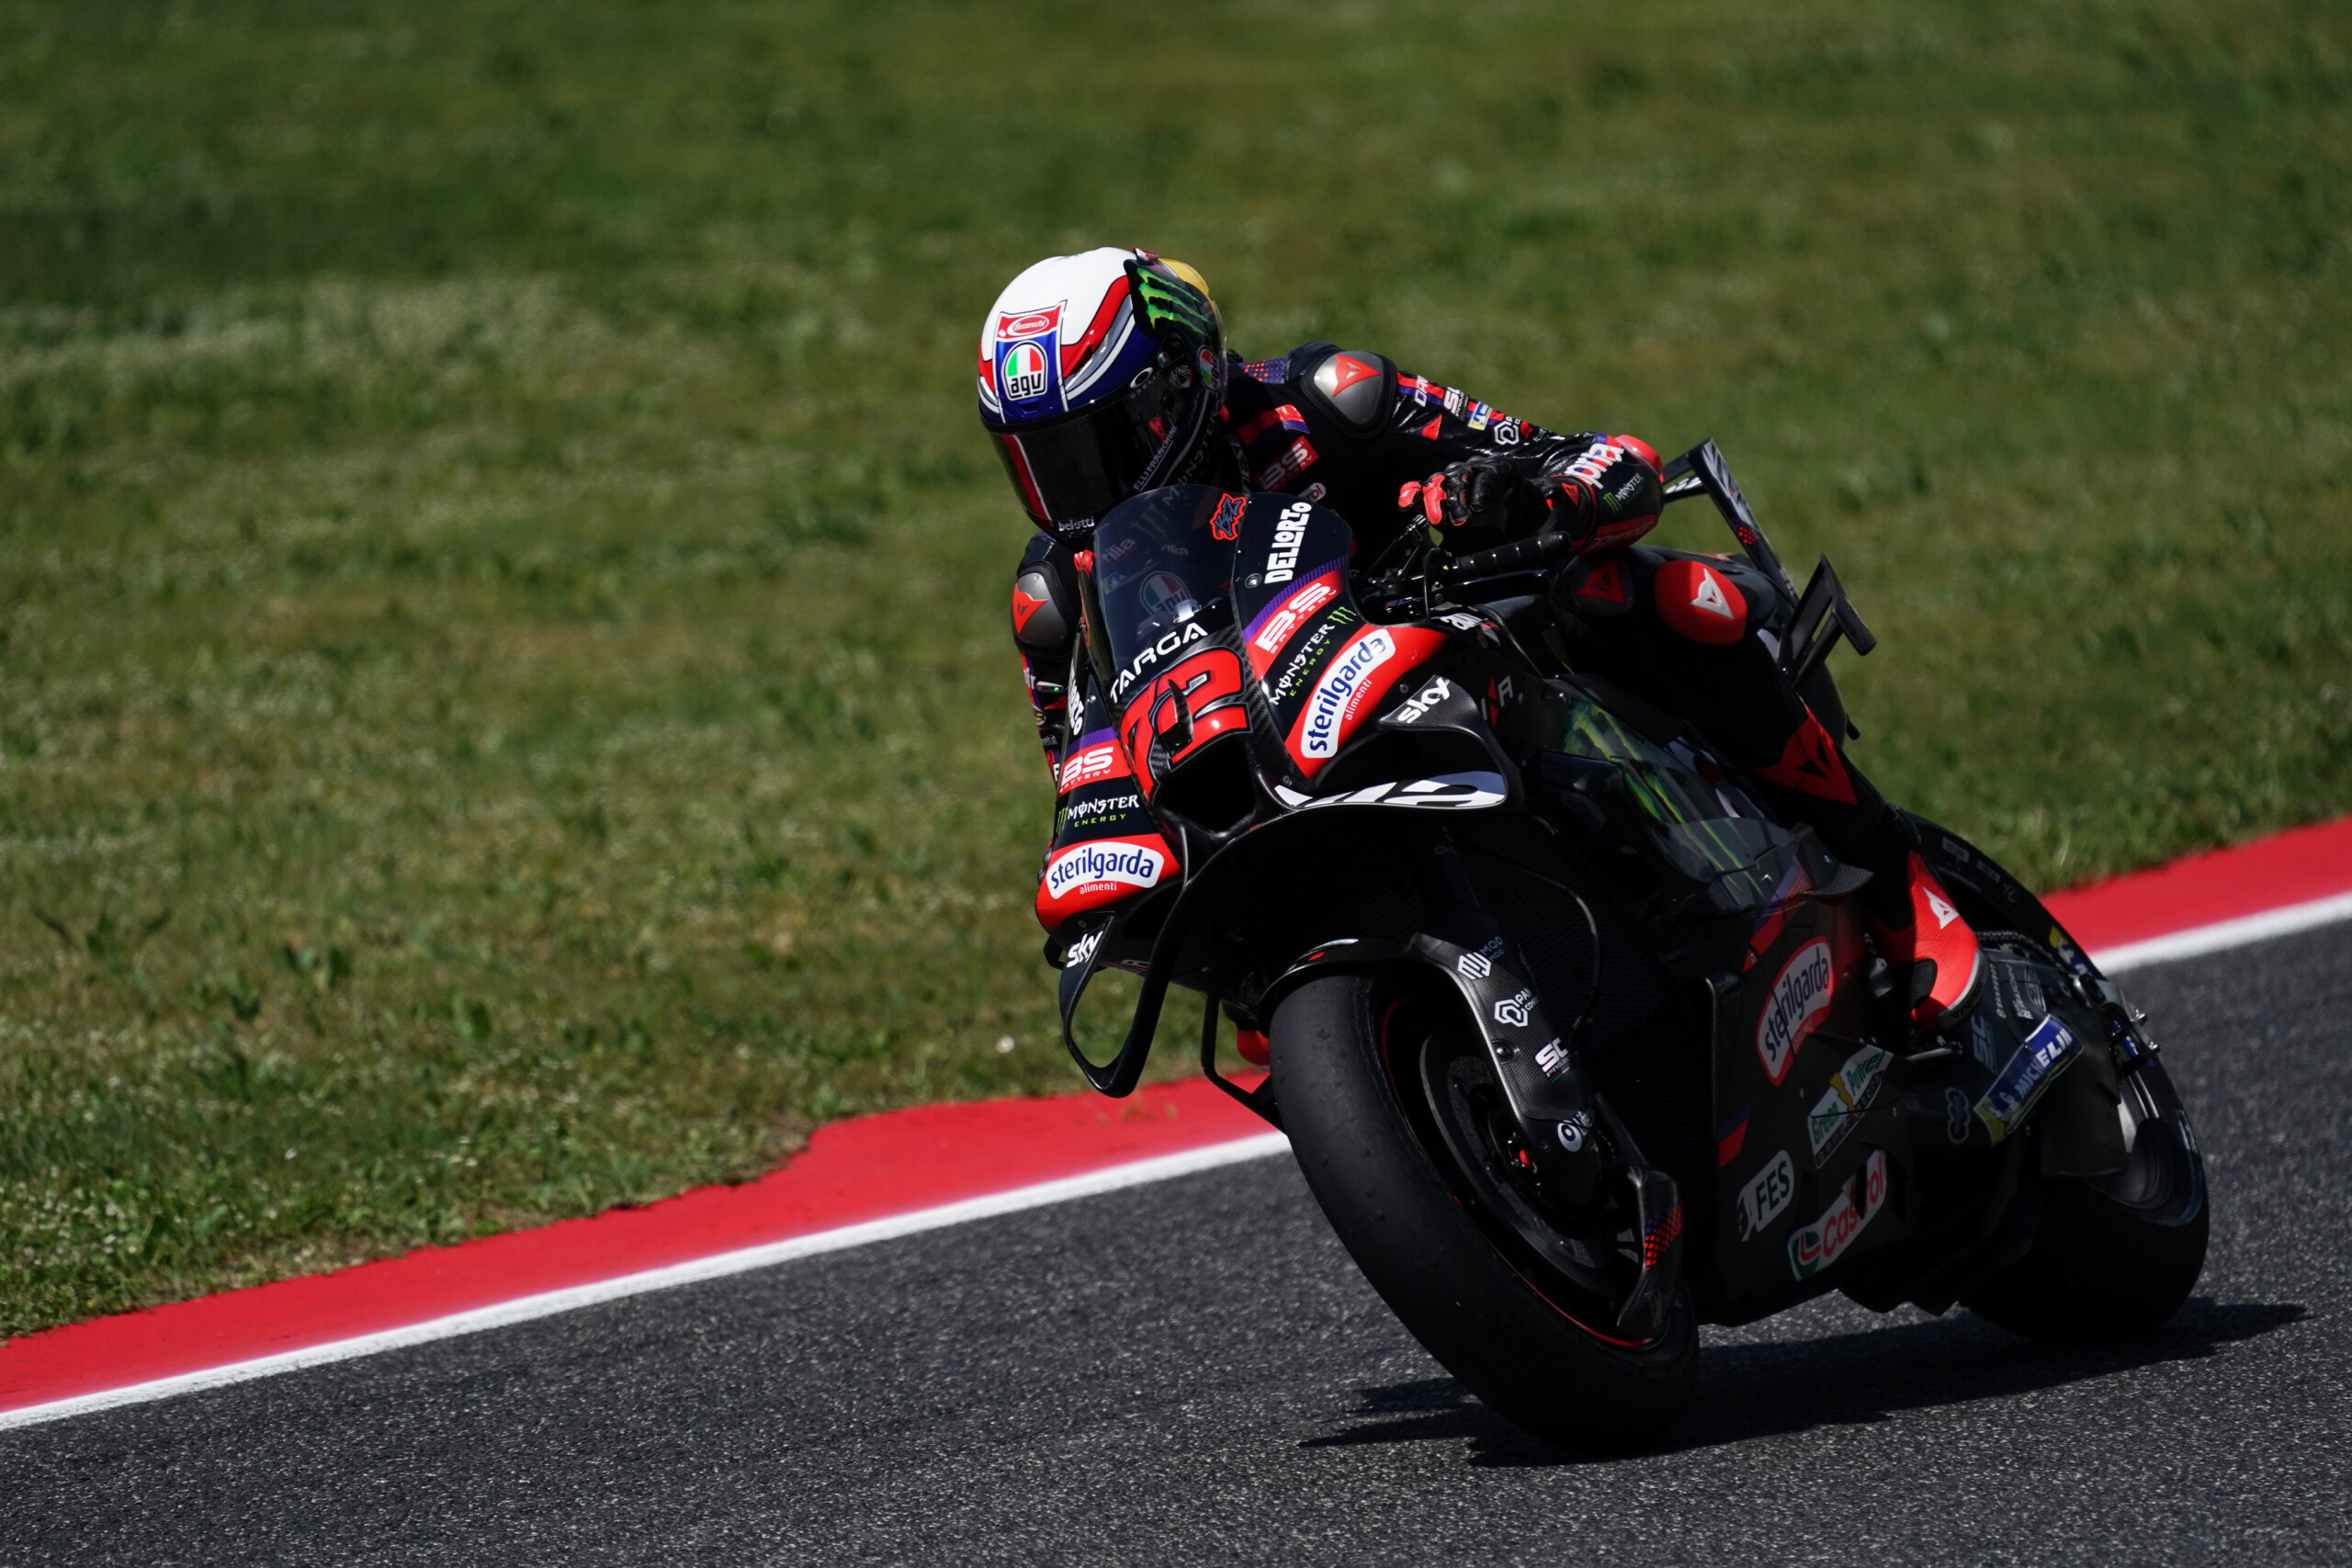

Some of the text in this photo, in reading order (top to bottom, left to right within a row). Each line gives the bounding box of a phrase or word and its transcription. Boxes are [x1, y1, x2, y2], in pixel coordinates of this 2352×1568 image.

[1011, 373, 1042, 396] agv
[1260, 443, 1308, 491] BS
[1255, 582, 1331, 653] BS
[1110, 622, 1208, 705] TARGA
[1269, 622, 1336, 705] MONSTER
[1289, 637, 1331, 698] ENERGY
[1309, 636, 1387, 752] sterilgarda
[1344, 678, 1374, 721] alimenti
[1397, 676, 1451, 724] sky
[1120, 646, 1252, 805] 72
[1059, 769, 1112, 794] BATTERY
[1060, 746, 1114, 788] BS
[1067, 794, 1140, 820] MONSTER
[1073, 813, 1126, 828] ENERGY
[1050, 846, 1155, 892] sterilgarda
[1079, 881, 1118, 895] alimenti
[1765, 946, 1829, 1062] sterilgarda
[1535, 1036, 1569, 1073] SC
[2014, 1028, 2074, 1100] MICHELIN
[1756, 1160, 1790, 1222] FES
